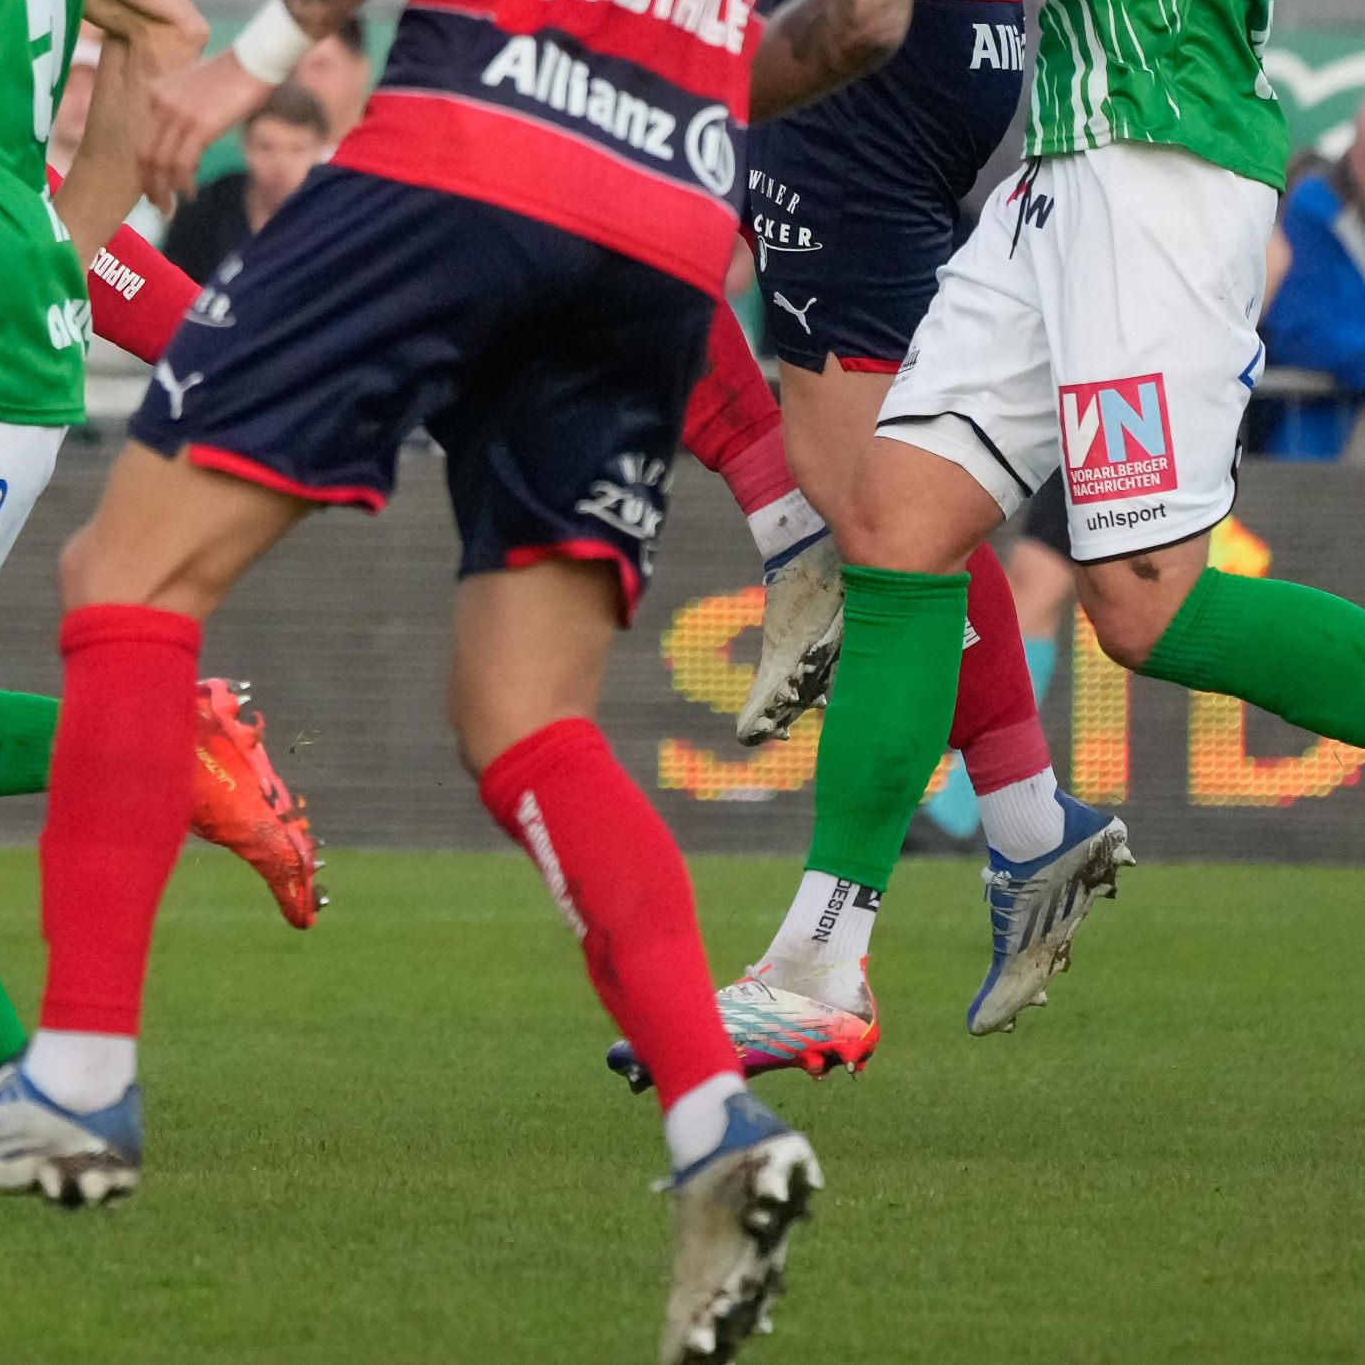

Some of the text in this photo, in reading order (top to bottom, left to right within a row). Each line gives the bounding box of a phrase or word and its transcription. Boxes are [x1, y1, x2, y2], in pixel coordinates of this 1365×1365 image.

[480, 34, 677, 162] Allianz
[1063, 381, 1167, 469] VN
[1070, 457, 1169, 483] VORARLBERGER
[1072, 473, 1162, 497] NACHRICHTEN
[1086, 502, 1167, 531] uhlsport
